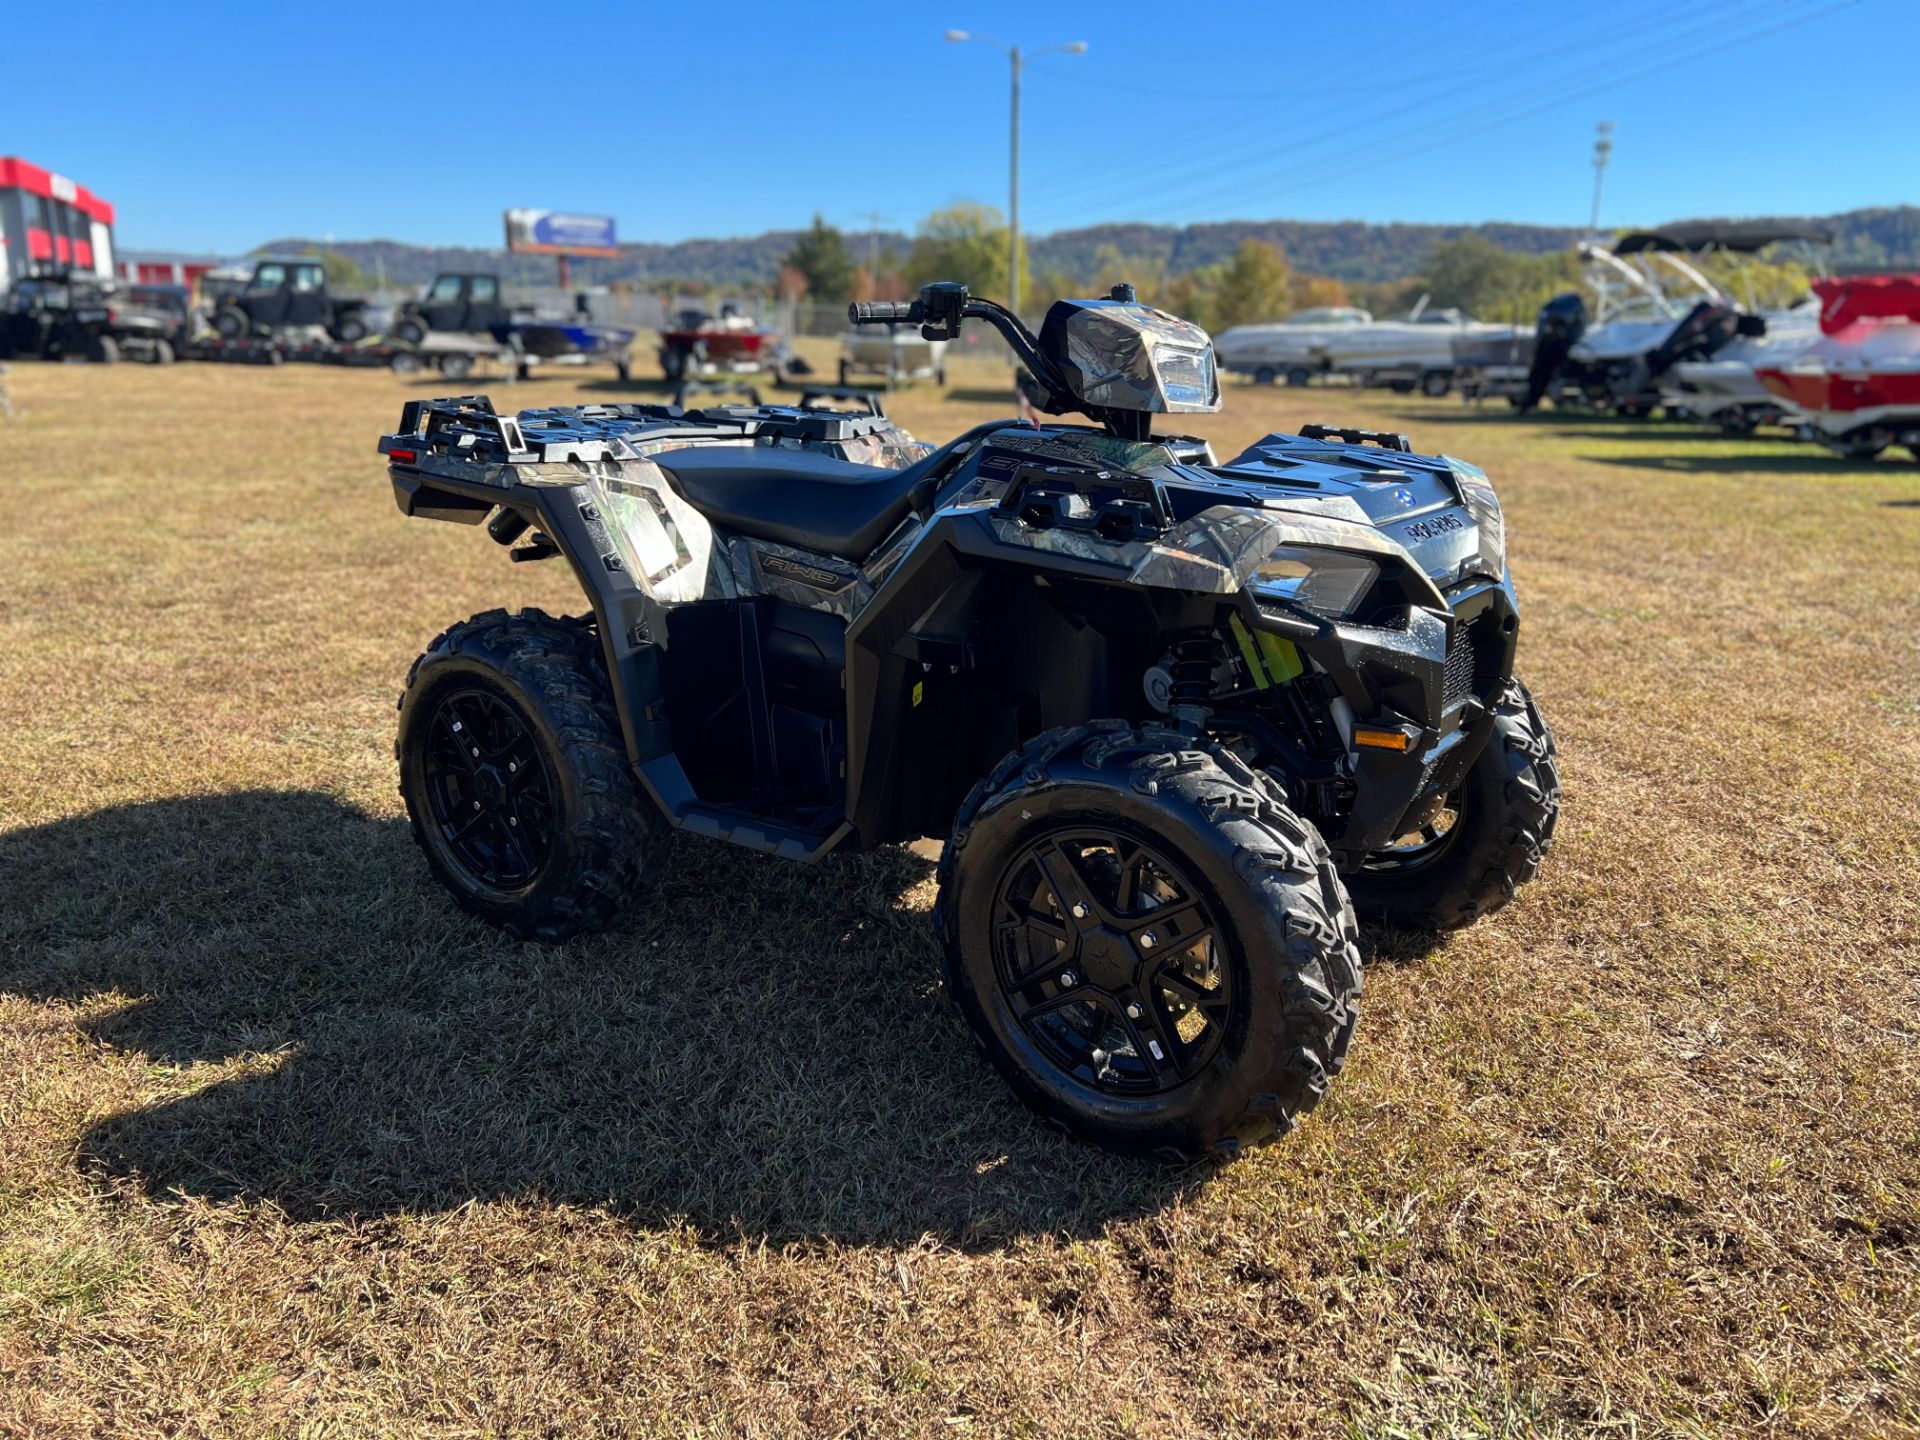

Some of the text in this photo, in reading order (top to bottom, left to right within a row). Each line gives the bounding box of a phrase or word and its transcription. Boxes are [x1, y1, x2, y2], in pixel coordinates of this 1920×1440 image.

[989, 436, 1106, 463] SPORTSMAN
[1404, 513, 1464, 543] POLARIS
[764, 556, 839, 585] AWD
